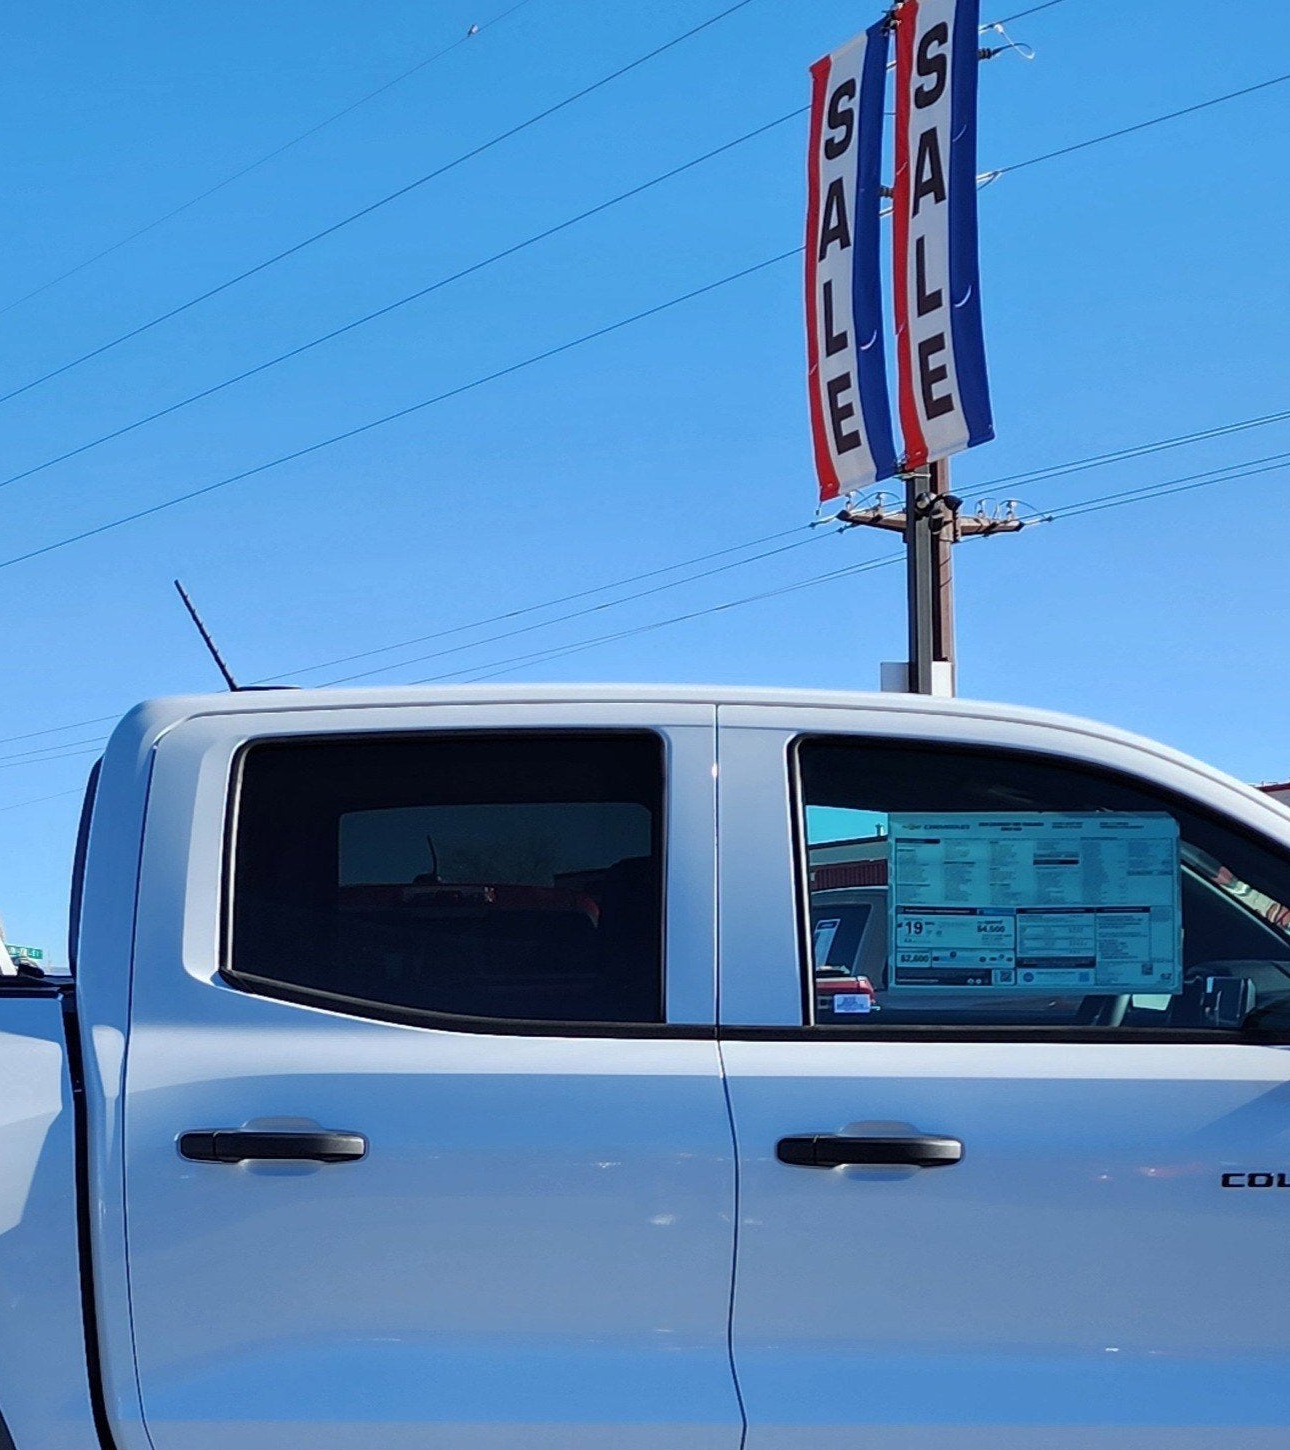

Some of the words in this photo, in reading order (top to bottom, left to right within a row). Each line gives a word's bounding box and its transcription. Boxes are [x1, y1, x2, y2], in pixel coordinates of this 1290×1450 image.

[818, 78, 862, 456] SALE
[911, 20, 954, 421] SALE
[905, 920, 924, 935] 19
